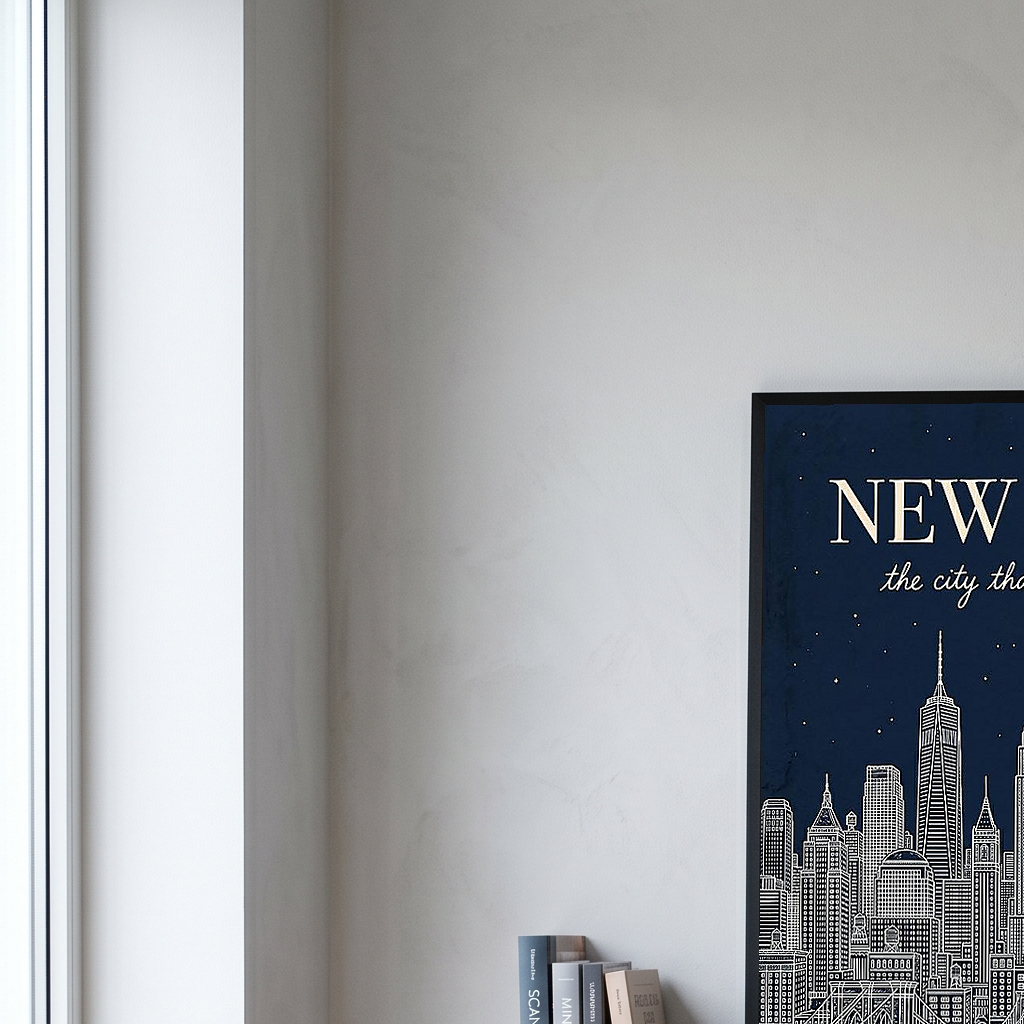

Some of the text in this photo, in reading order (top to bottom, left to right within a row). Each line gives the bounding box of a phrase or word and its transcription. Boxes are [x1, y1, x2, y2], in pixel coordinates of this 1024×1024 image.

[828, 478, 1018, 544] NEW
[879, 561, 924, 592] the
[933, 564, 980, 609] city
